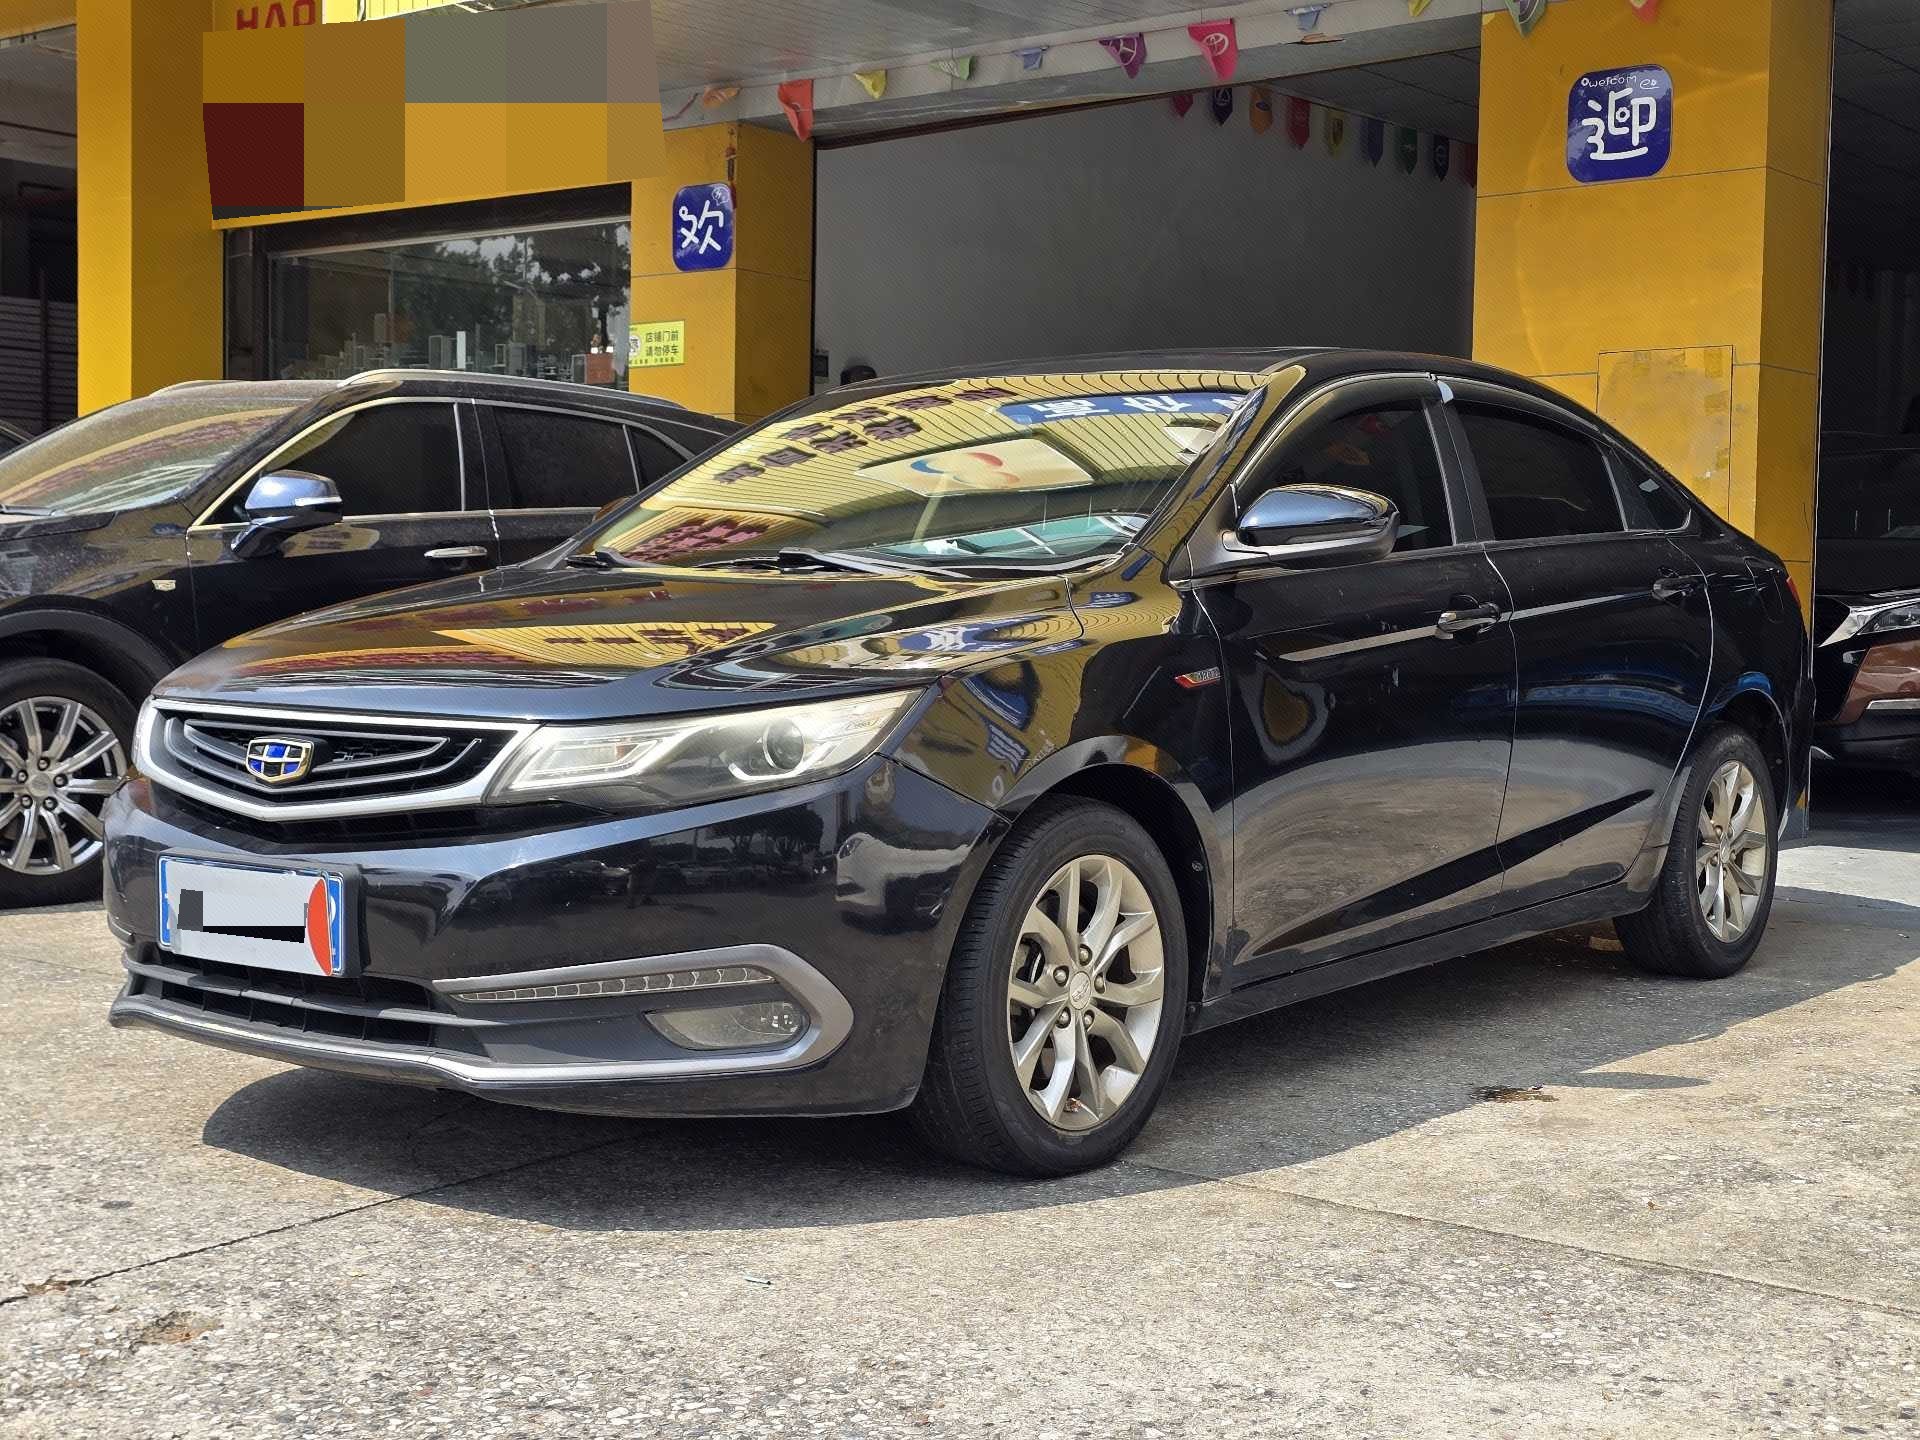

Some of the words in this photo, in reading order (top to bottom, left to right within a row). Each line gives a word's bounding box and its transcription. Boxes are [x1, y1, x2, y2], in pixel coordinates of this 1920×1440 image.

[1581, 87, 1656, 161] 迎
[678, 199, 724, 255] 欢
[645, 329, 679, 343] 店铺门前
[645, 344, 679, 357] 请勿停车
